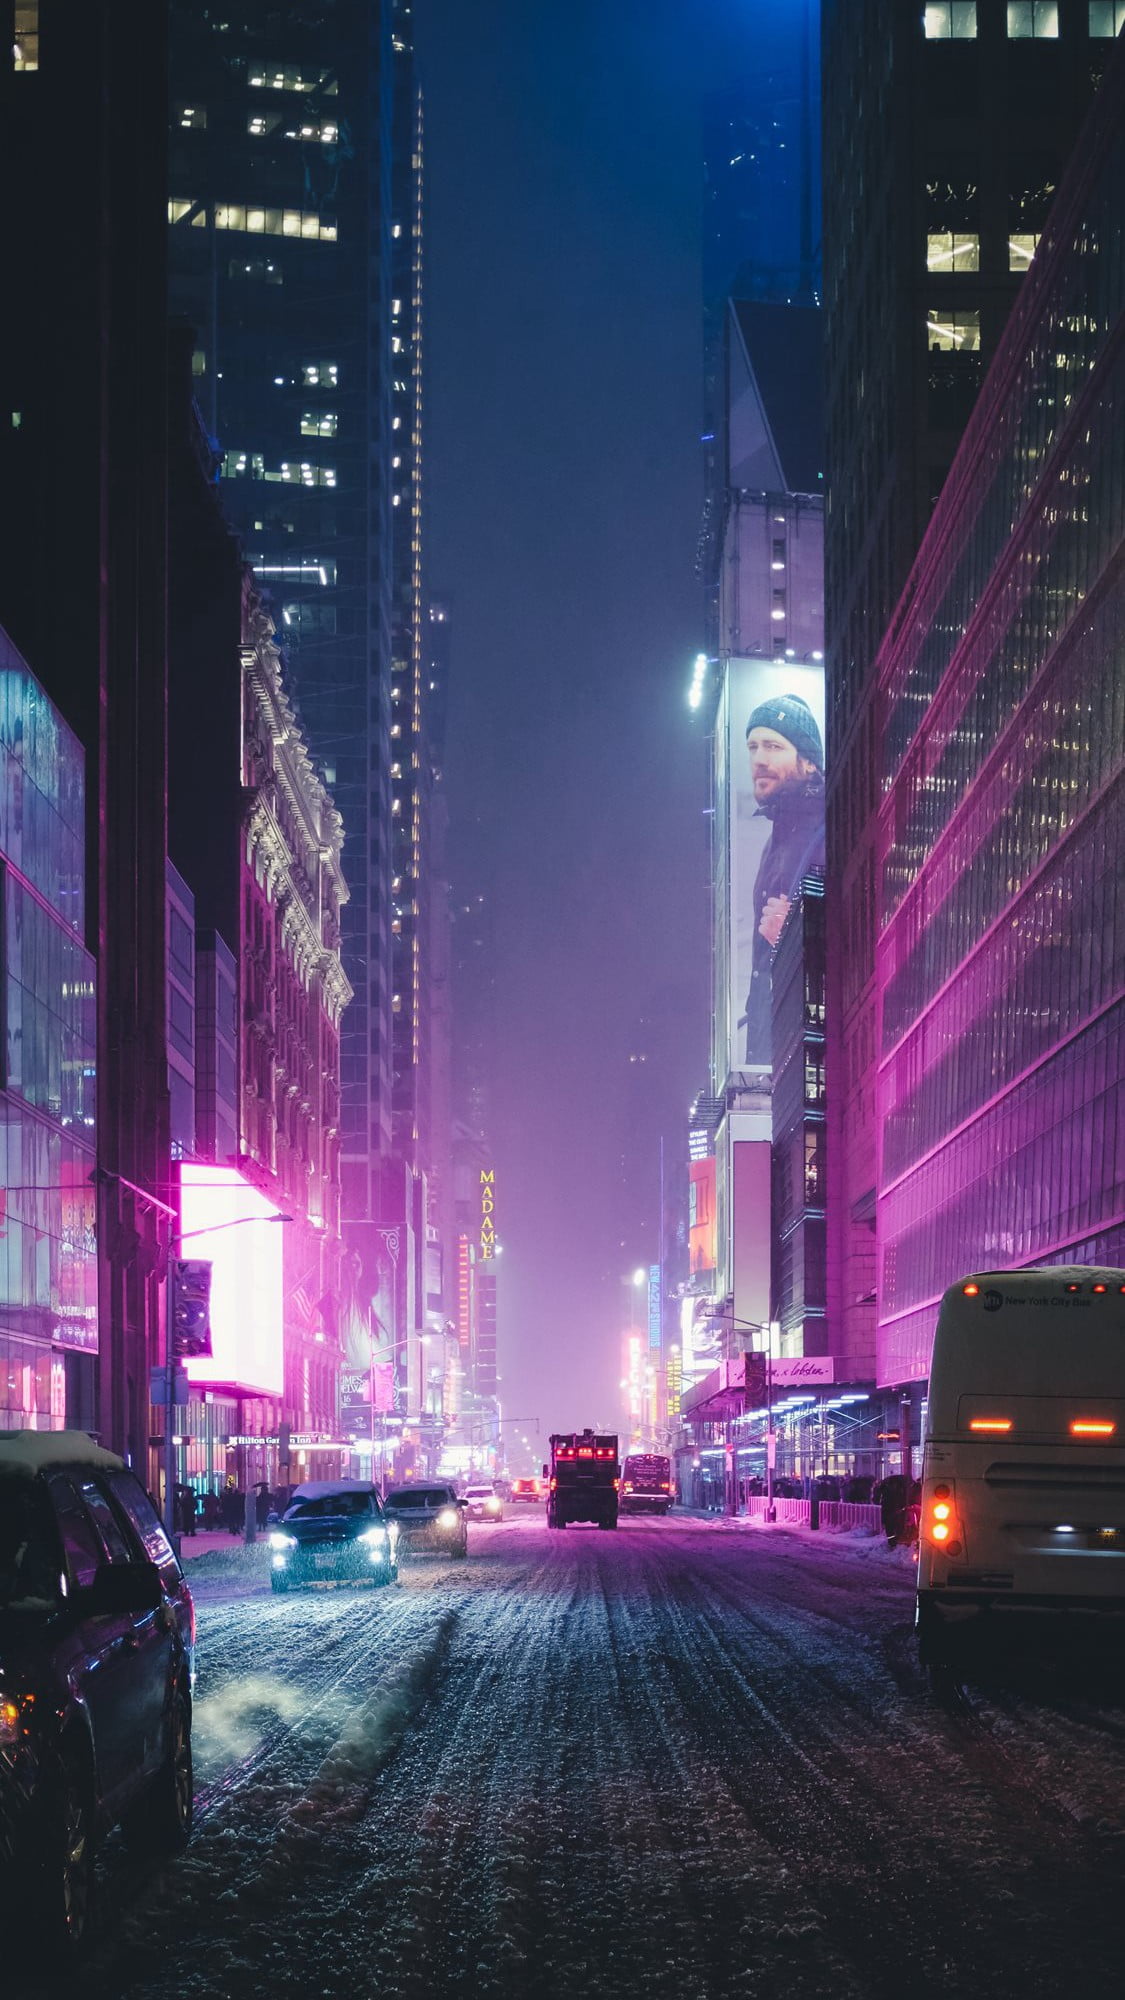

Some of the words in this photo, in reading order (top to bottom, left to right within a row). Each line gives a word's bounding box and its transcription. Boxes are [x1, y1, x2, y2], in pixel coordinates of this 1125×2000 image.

[480, 1169, 494, 1259] MADAME
[1005, 1296, 1026, 1305] New
[1029, 1296, 1048, 1305] York
[1051, 1297, 1070, 1308] City
[1072, 1297, 1090, 1307] Bus
[238, 1436, 265, 1445] Hilton
[266, 1436, 294, 1445] Garn
[296, 1436, 312, 1445] Inn
